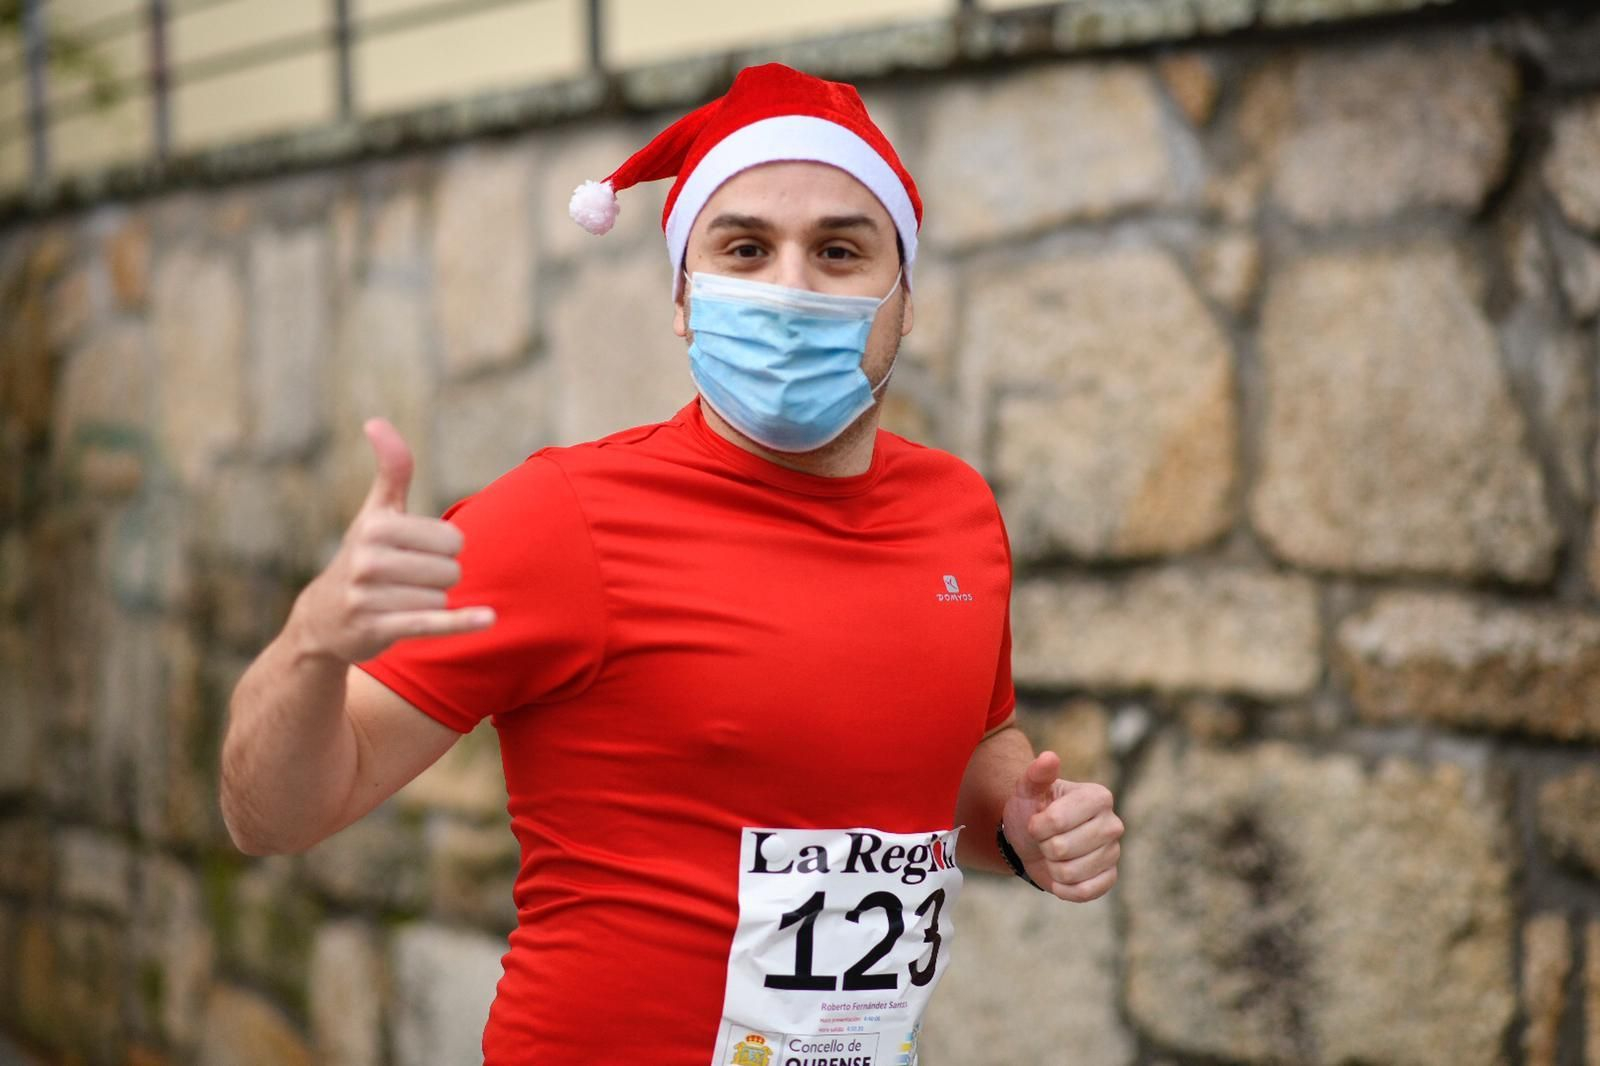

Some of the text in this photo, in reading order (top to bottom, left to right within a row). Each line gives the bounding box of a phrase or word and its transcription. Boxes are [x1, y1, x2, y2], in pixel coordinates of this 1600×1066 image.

[936, 593, 973, 602] DOMYOS
[748, 831, 831, 874] La
[764, 888, 946, 991] 123
[821, 1002, 850, 1011] Roberto
[852, 1001, 887, 1010] Fernández
[789, 1039, 862, 1053] Concello de
